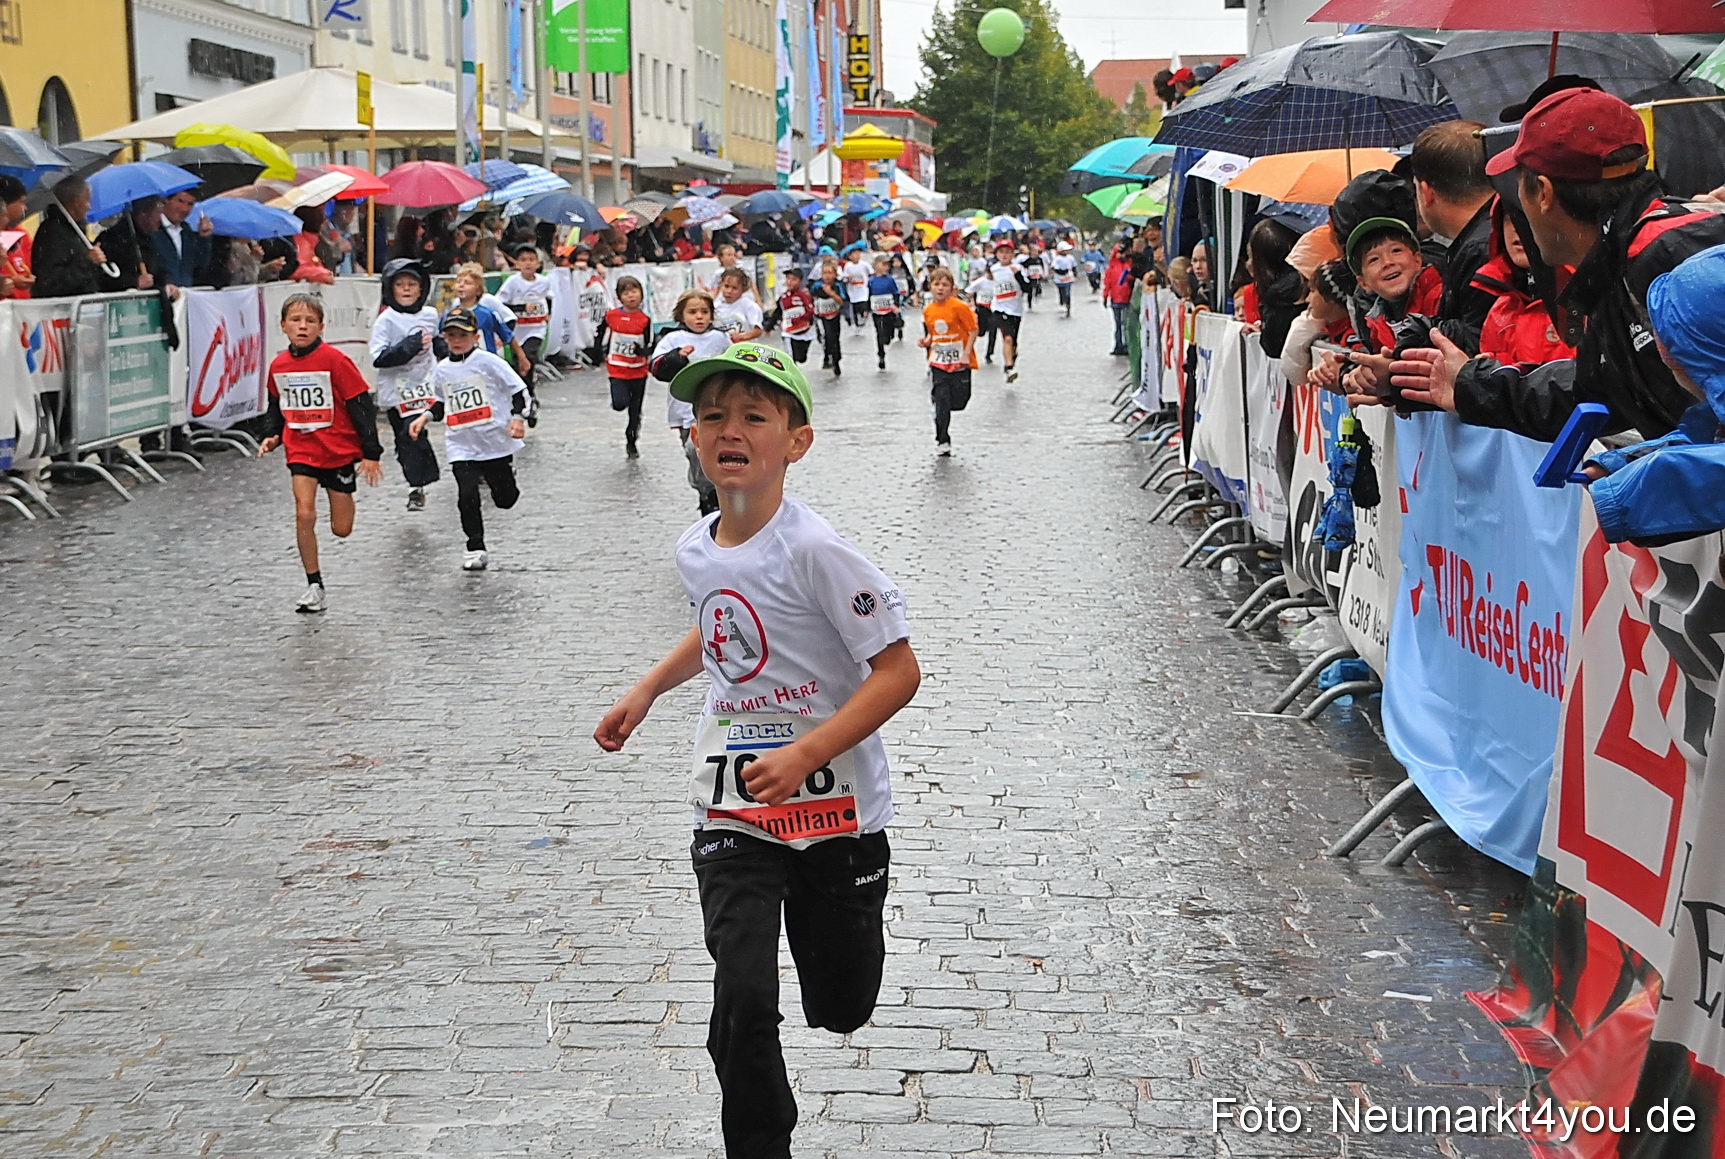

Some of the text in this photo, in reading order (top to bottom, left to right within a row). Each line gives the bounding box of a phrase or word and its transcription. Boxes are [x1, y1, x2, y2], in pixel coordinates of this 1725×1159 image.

[283, 387, 324, 408] 7103
[448, 389, 483, 412] 7120
[1426, 544, 1570, 703] TUIReiseCent
[741, 696, 768, 712] MIT
[774, 680, 819, 705] HERZ
[727, 722, 795, 740] BOCK
[751, 810, 840, 835] imilian
[723, 837, 738, 849] M.
[855, 873, 880, 887] JAKO
